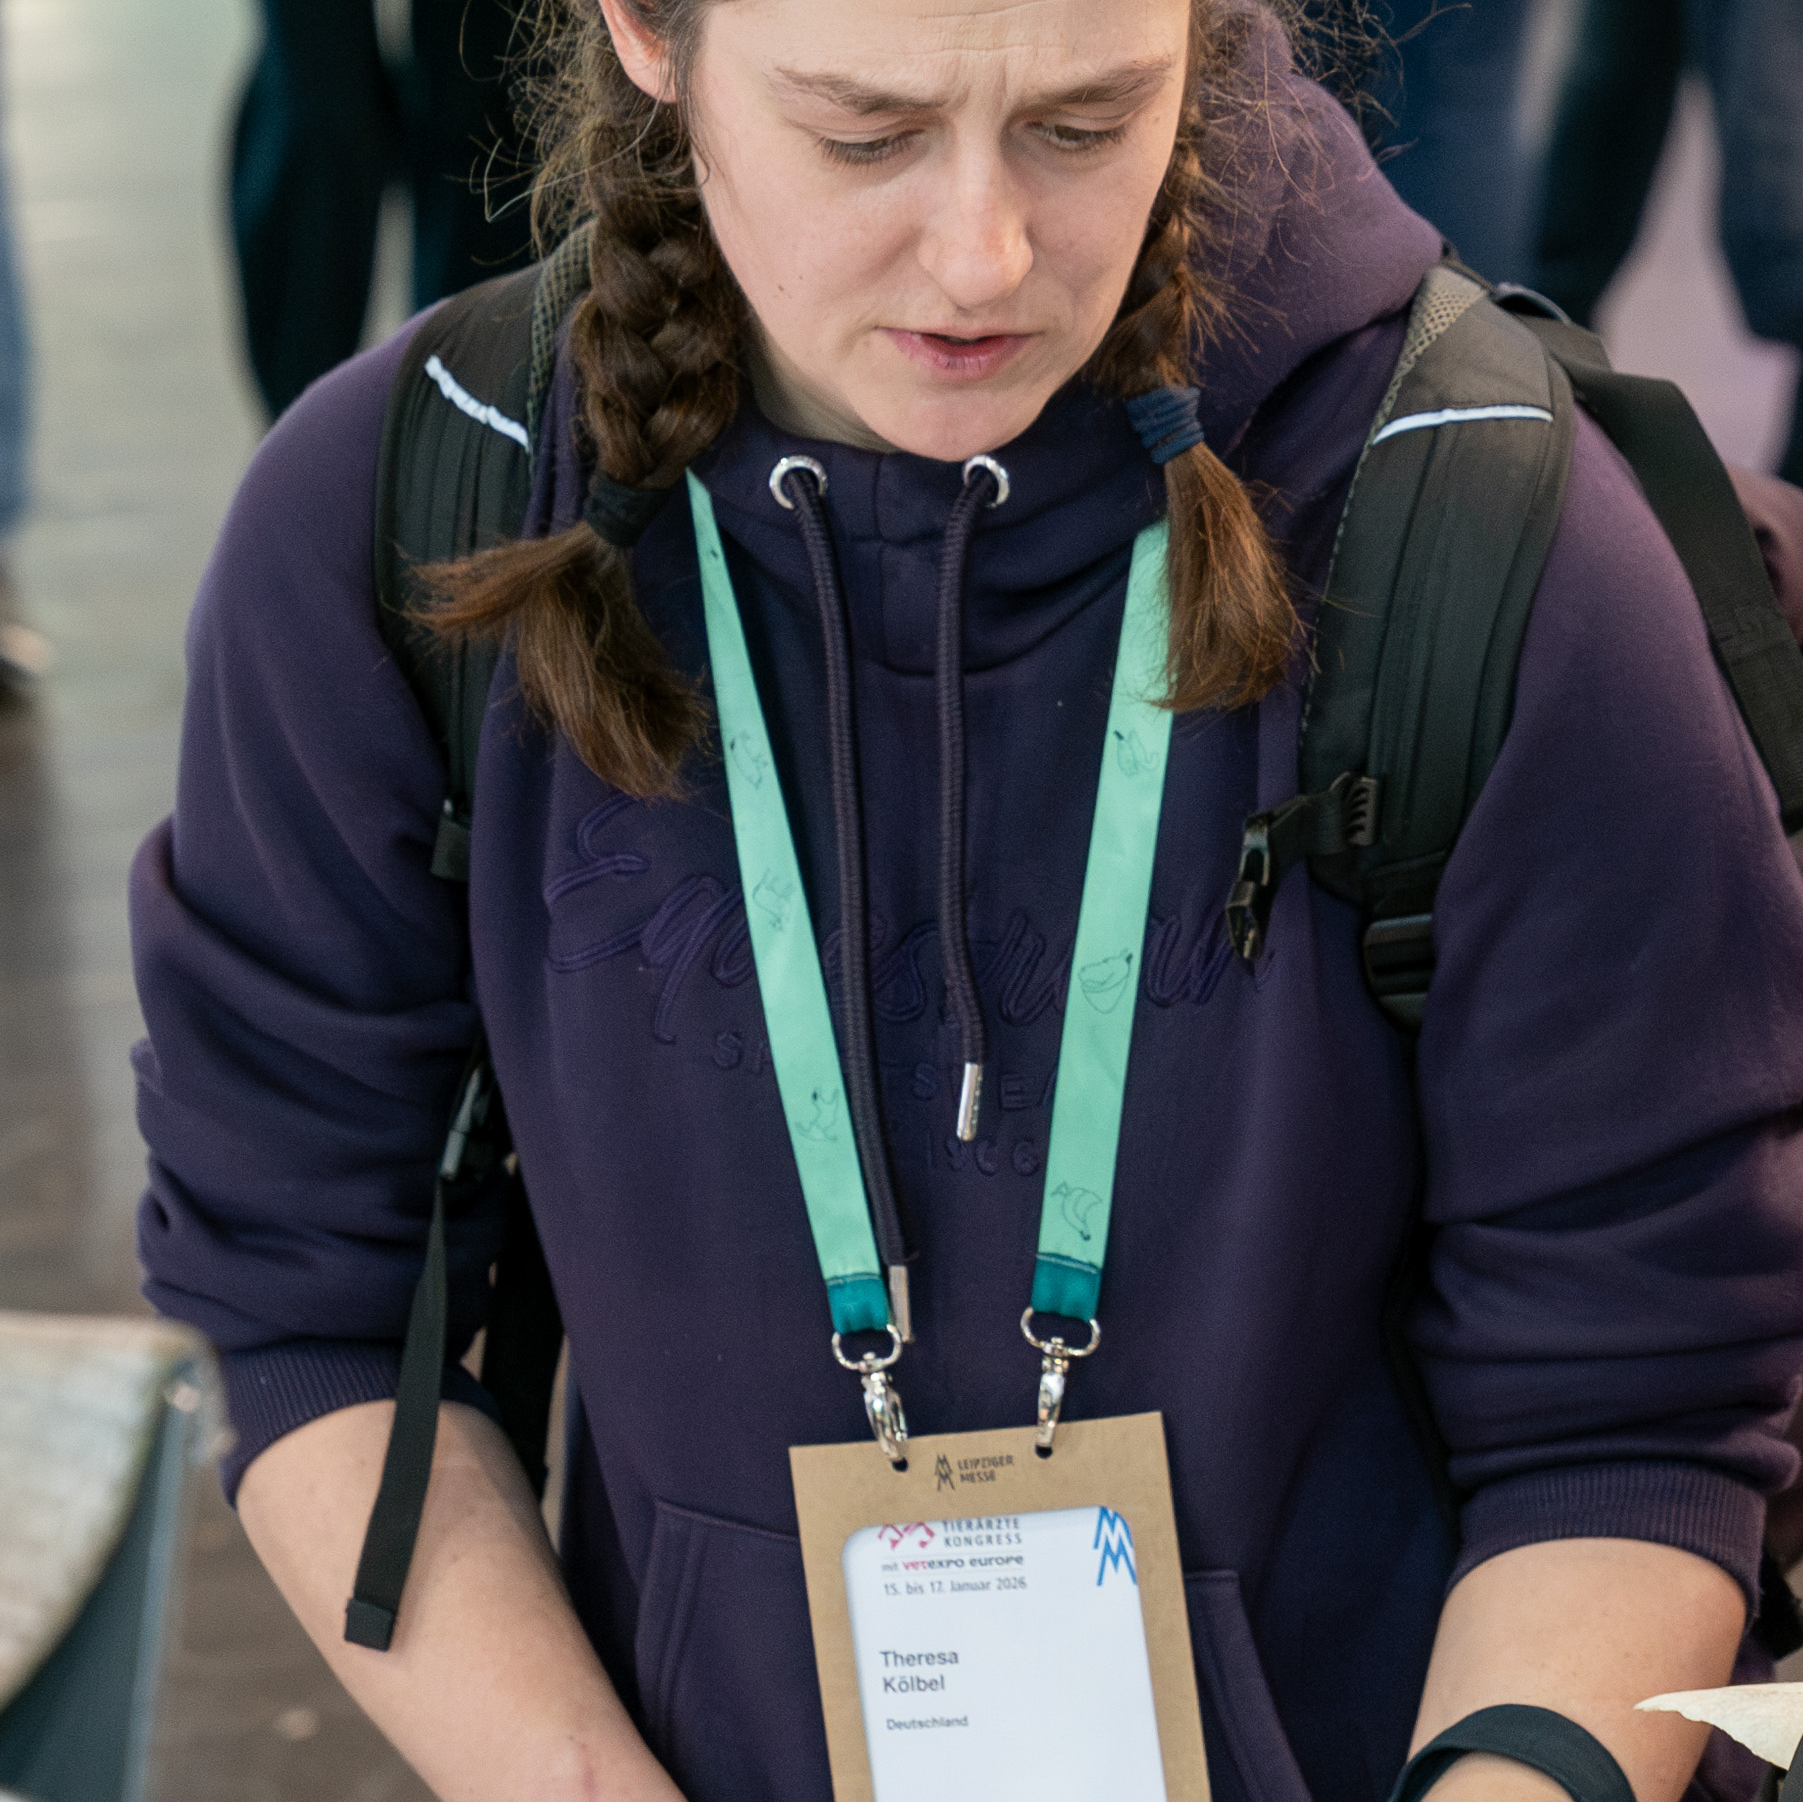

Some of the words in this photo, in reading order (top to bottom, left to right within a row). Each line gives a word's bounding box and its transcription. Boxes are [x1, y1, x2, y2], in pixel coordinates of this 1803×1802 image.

[957, 1454, 1014, 1470] LEIPZIGER
[959, 1471, 996, 1483] MESSE
[943, 1533, 1022, 1548] KONGRESS
[969, 1555, 1024, 1569] europe
[884, 1582, 900, 1596] 15.
[906, 1582, 924, 1595] bis
[950, 1579, 991, 1592] Januar
[996, 1576, 1028, 1590] 2026
[879, 1650, 960, 1668] Theresa
[882, 1674, 946, 1693] Kölbel
[886, 1716, 969, 1730] Deutschland
